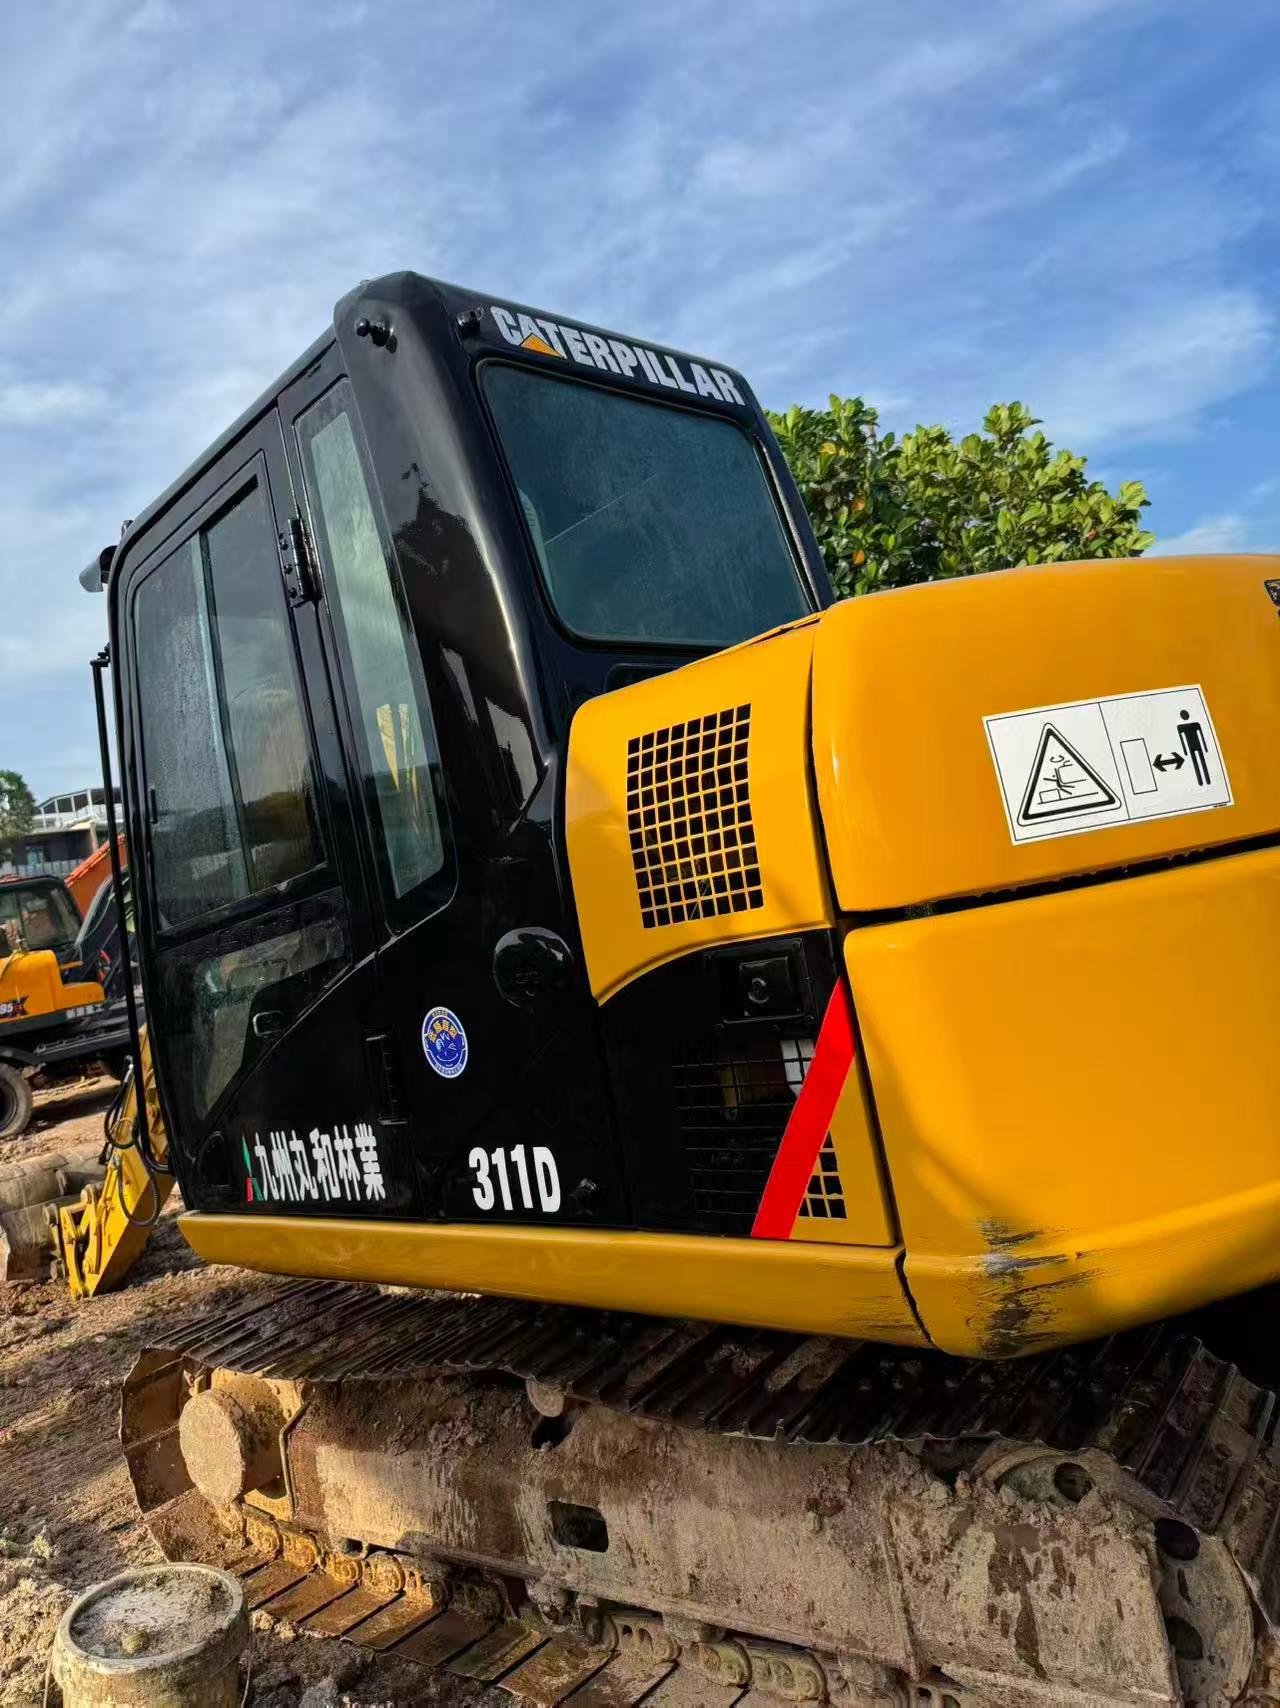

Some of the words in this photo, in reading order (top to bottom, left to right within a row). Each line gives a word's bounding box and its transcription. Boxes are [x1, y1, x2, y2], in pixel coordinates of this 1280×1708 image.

[490, 306, 745, 406] CATERPILLAR
[254, 1123, 386, 1201] 九州丸和林業
[468, 1144, 561, 1213] 311D
